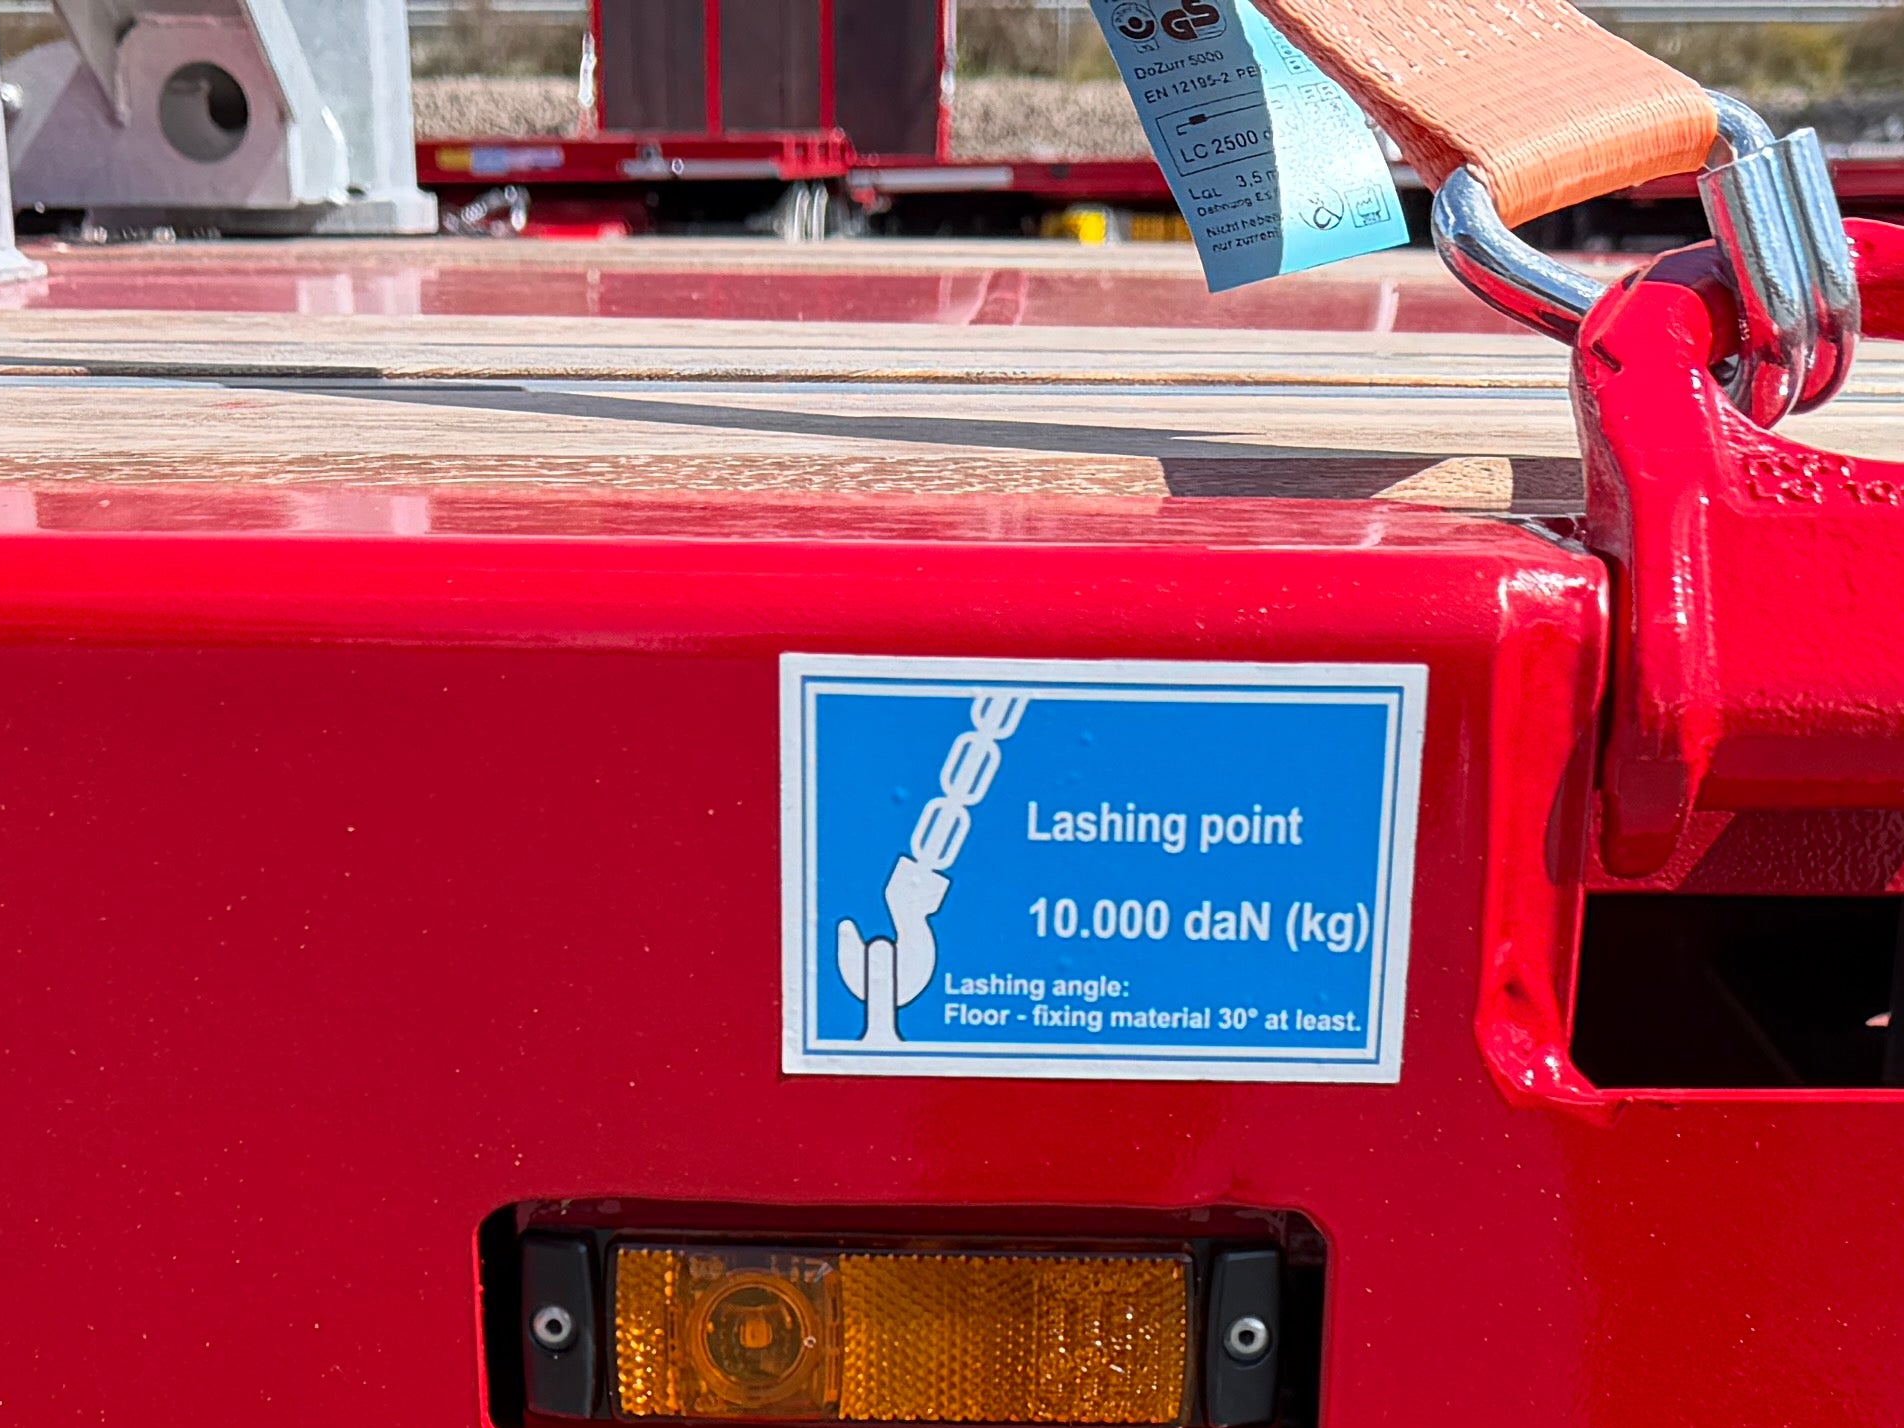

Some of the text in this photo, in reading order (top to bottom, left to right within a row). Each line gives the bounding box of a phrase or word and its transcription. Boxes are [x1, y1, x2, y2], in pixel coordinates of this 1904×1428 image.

[1134, 50, 1224, 80] DoZurr 5000
[1144, 90, 1169, 104] EN
[1180, 143, 1209, 163] LC
[1212, 129, 1259, 155] 2500
[1235, 170, 1262, 187] 3,5
[1206, 221, 1240, 238] Nicht
[1212, 240, 1232, 252] nur
[1027, 801, 1303, 854] Lashing point
[1029, 897, 1369, 953] 10.000 daN (kg)
[945, 973, 1130, 1002] Lashing angle:
[944, 1003, 1010, 1026] Floor
[1032, 1004, 1103, 1033] fixing
[1111, 1007, 1211, 1029] material
[1265, 1010, 1288, 1030] at
[1296, 1009, 1361, 1032] least.
